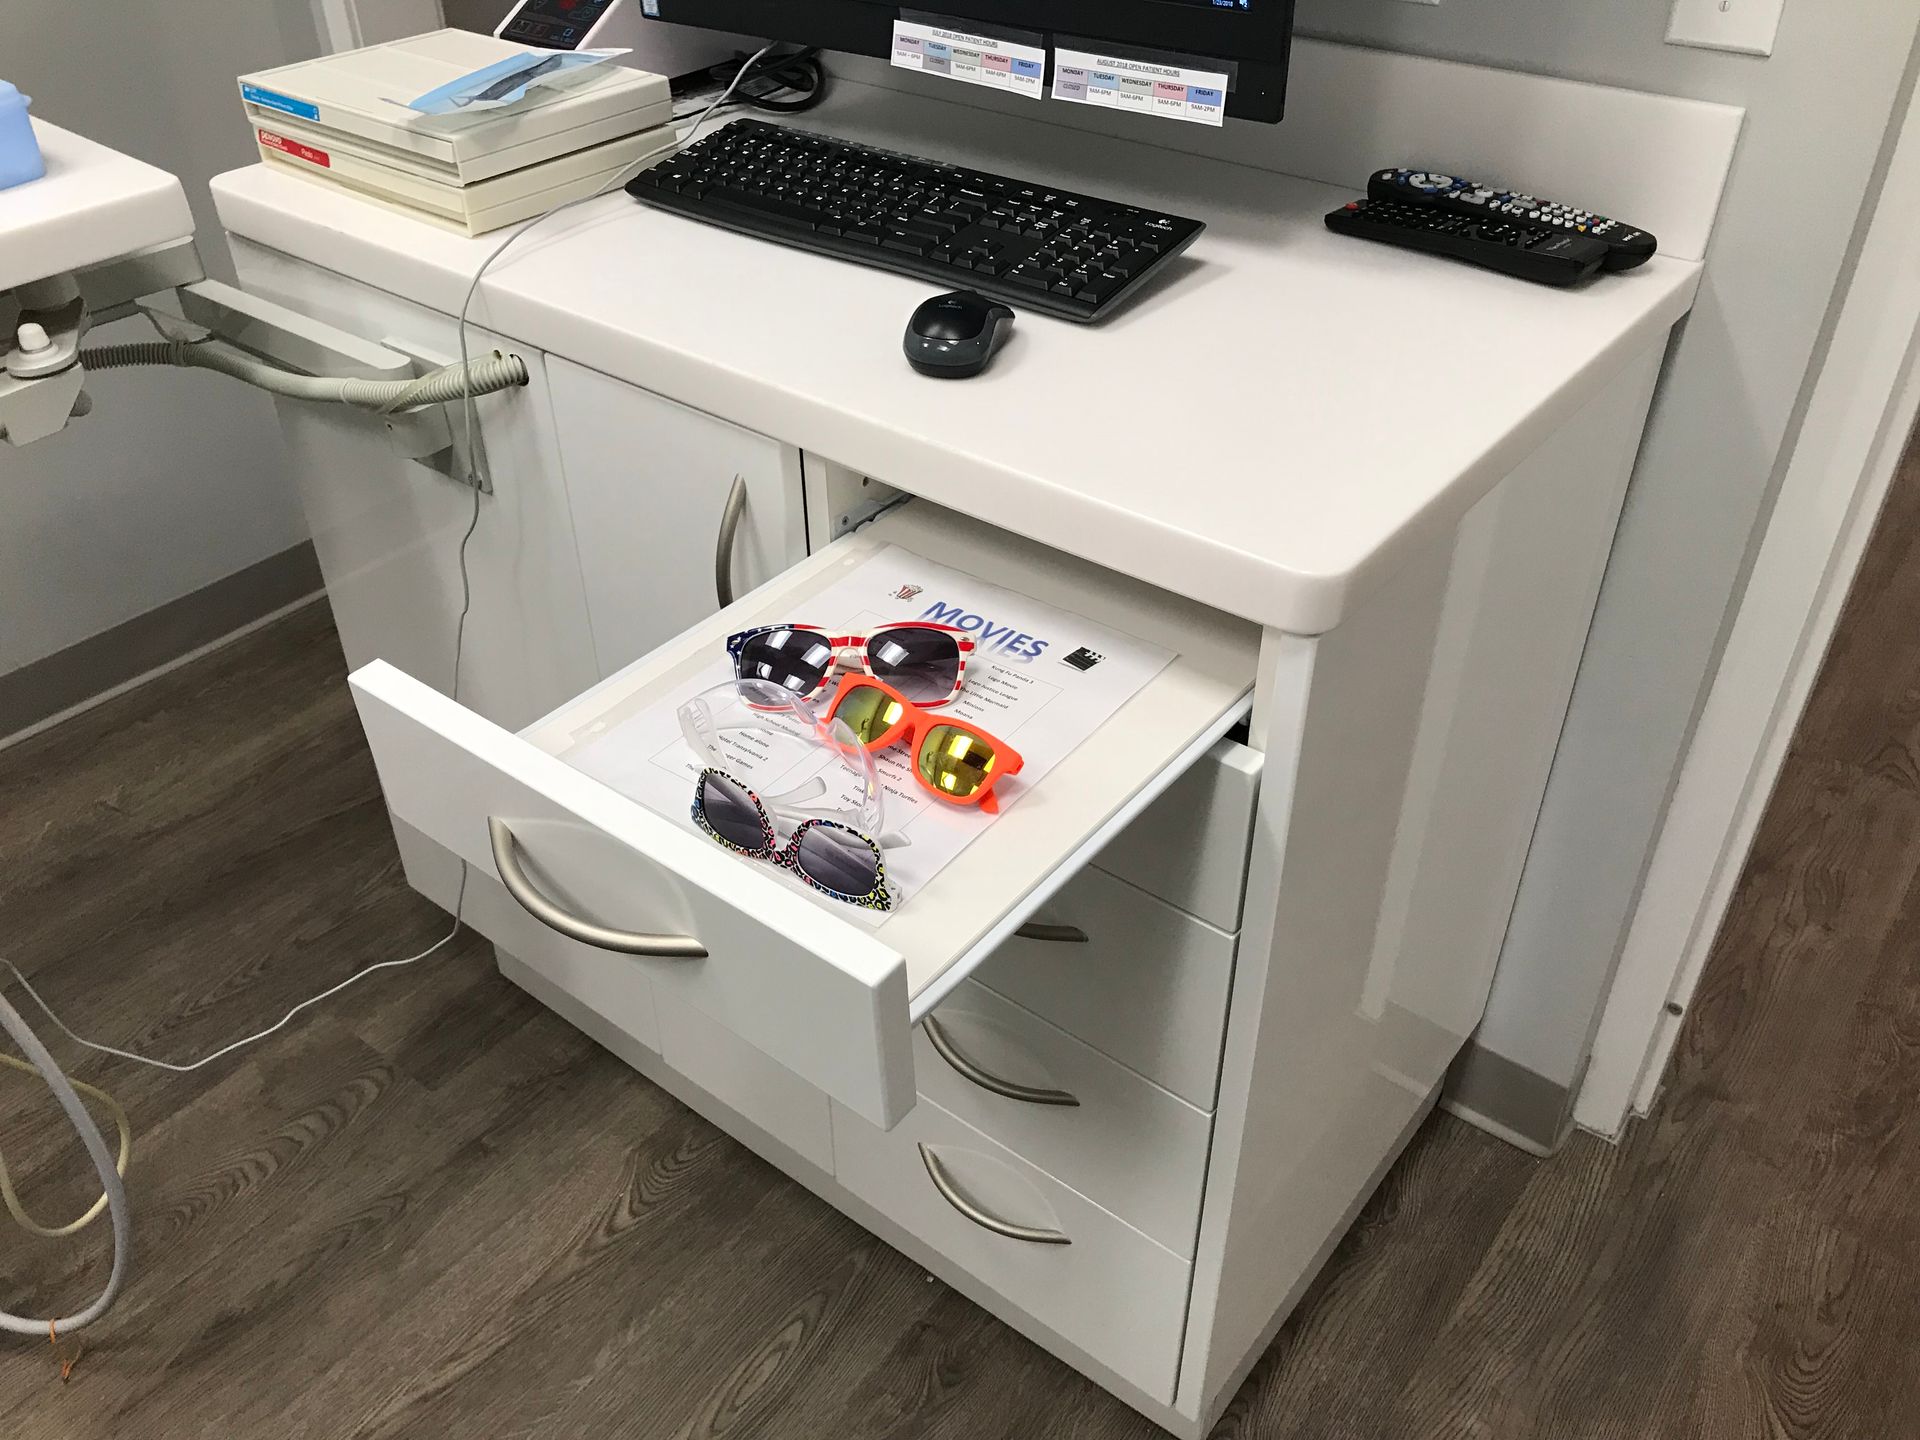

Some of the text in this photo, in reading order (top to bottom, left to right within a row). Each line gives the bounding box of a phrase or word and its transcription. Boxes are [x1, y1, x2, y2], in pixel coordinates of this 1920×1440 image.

[952, 32, 964, 41] OPEN
[965, 34, 982, 45] PATIENT
[983, 38, 998, 48] HOURS
[900, 37, 1035, 69] MONDAY TUESDAY WEDNESDAY THURSDAY FRIDAY
[929, 57, 945, 66] CLOSED
[1097, 58, 1180, 77] AUGUST 2018 OPEN PATIENT HOURS
[1062, 68, 1214, 97] MONDAY TUESDAY WEDNESDAY THURSDAY FRIDAY
[922, 600, 1049, 658] MOVIES
[988, 675, 1018, 690] Lego Movie
[992, 665, 1005, 673] Kung
[1013, 673, 1029, 683] Panda
[968, 678, 1018, 701] Lego Justice League
[963, 700, 984, 712] Minions
[970, 690, 984, 699] Little
[984, 697, 1009, 709] Mermaid
[954, 709, 973, 720] Moana
[739, 731, 769, 748] Home alone
[732, 741, 763, 759] Transylvania
[736, 758, 754, 769] Games
[879, 754, 896, 765] Shaun
[896, 762, 906, 770] the
[878, 768, 897, 781] Smurfs
[883, 785, 899, 795] Ninja
[899, 792, 918, 804] Turtles
